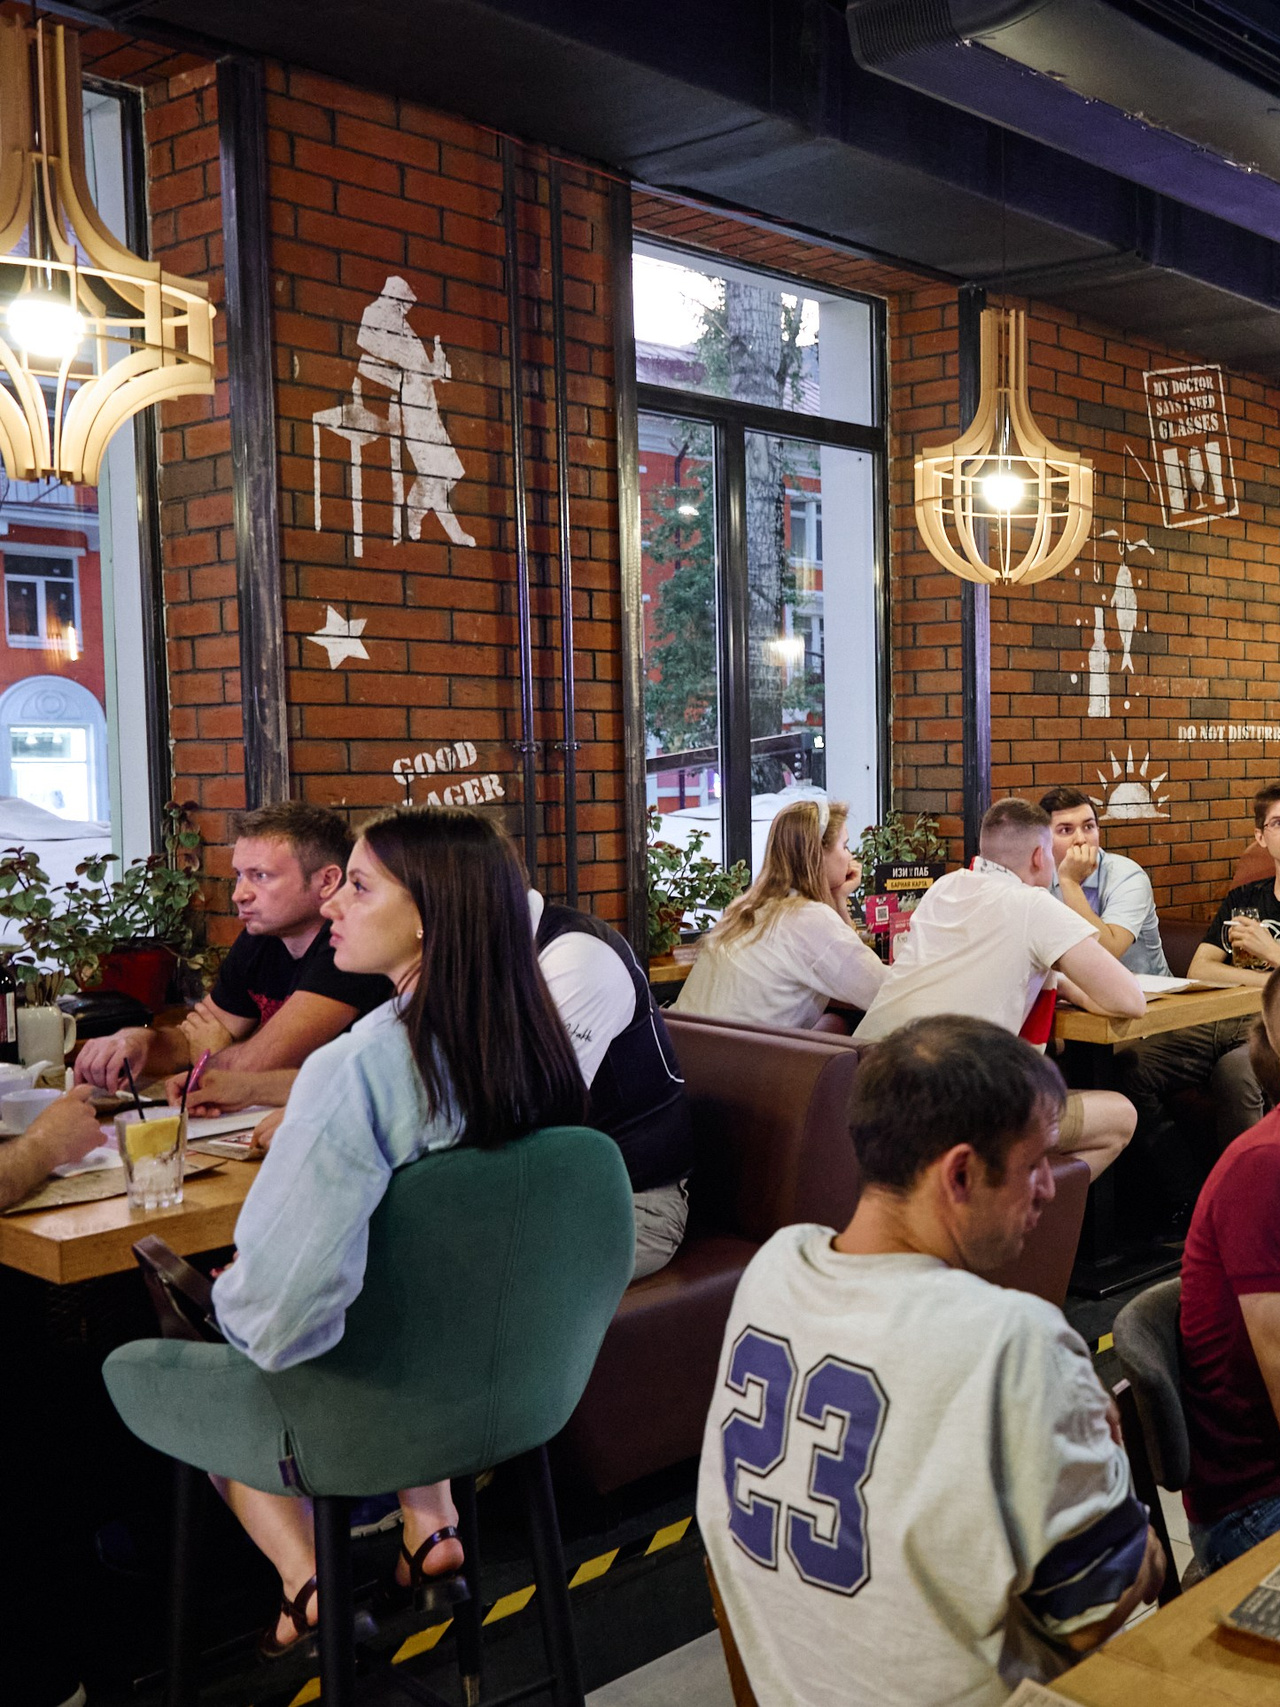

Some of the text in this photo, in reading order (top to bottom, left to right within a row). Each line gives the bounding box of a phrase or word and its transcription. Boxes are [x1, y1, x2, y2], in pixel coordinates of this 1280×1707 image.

[1153, 376, 1214, 397] MY DOCTOR
[1156, 400, 1182, 417] SAYS
[1189, 394, 1216, 411] NEED
[1159, 413, 1219, 440] GLASSES
[1178, 724, 1280, 743] DO NOT DISTURB
[393, 741, 478, 785] GOOD
[402, 774, 505, 806] AGER
[892, 866, 929, 878] ИЗИ ПАБ
[890, 881, 911, 889] БАРНАЯ
[721, 1324, 890, 1597] 23
